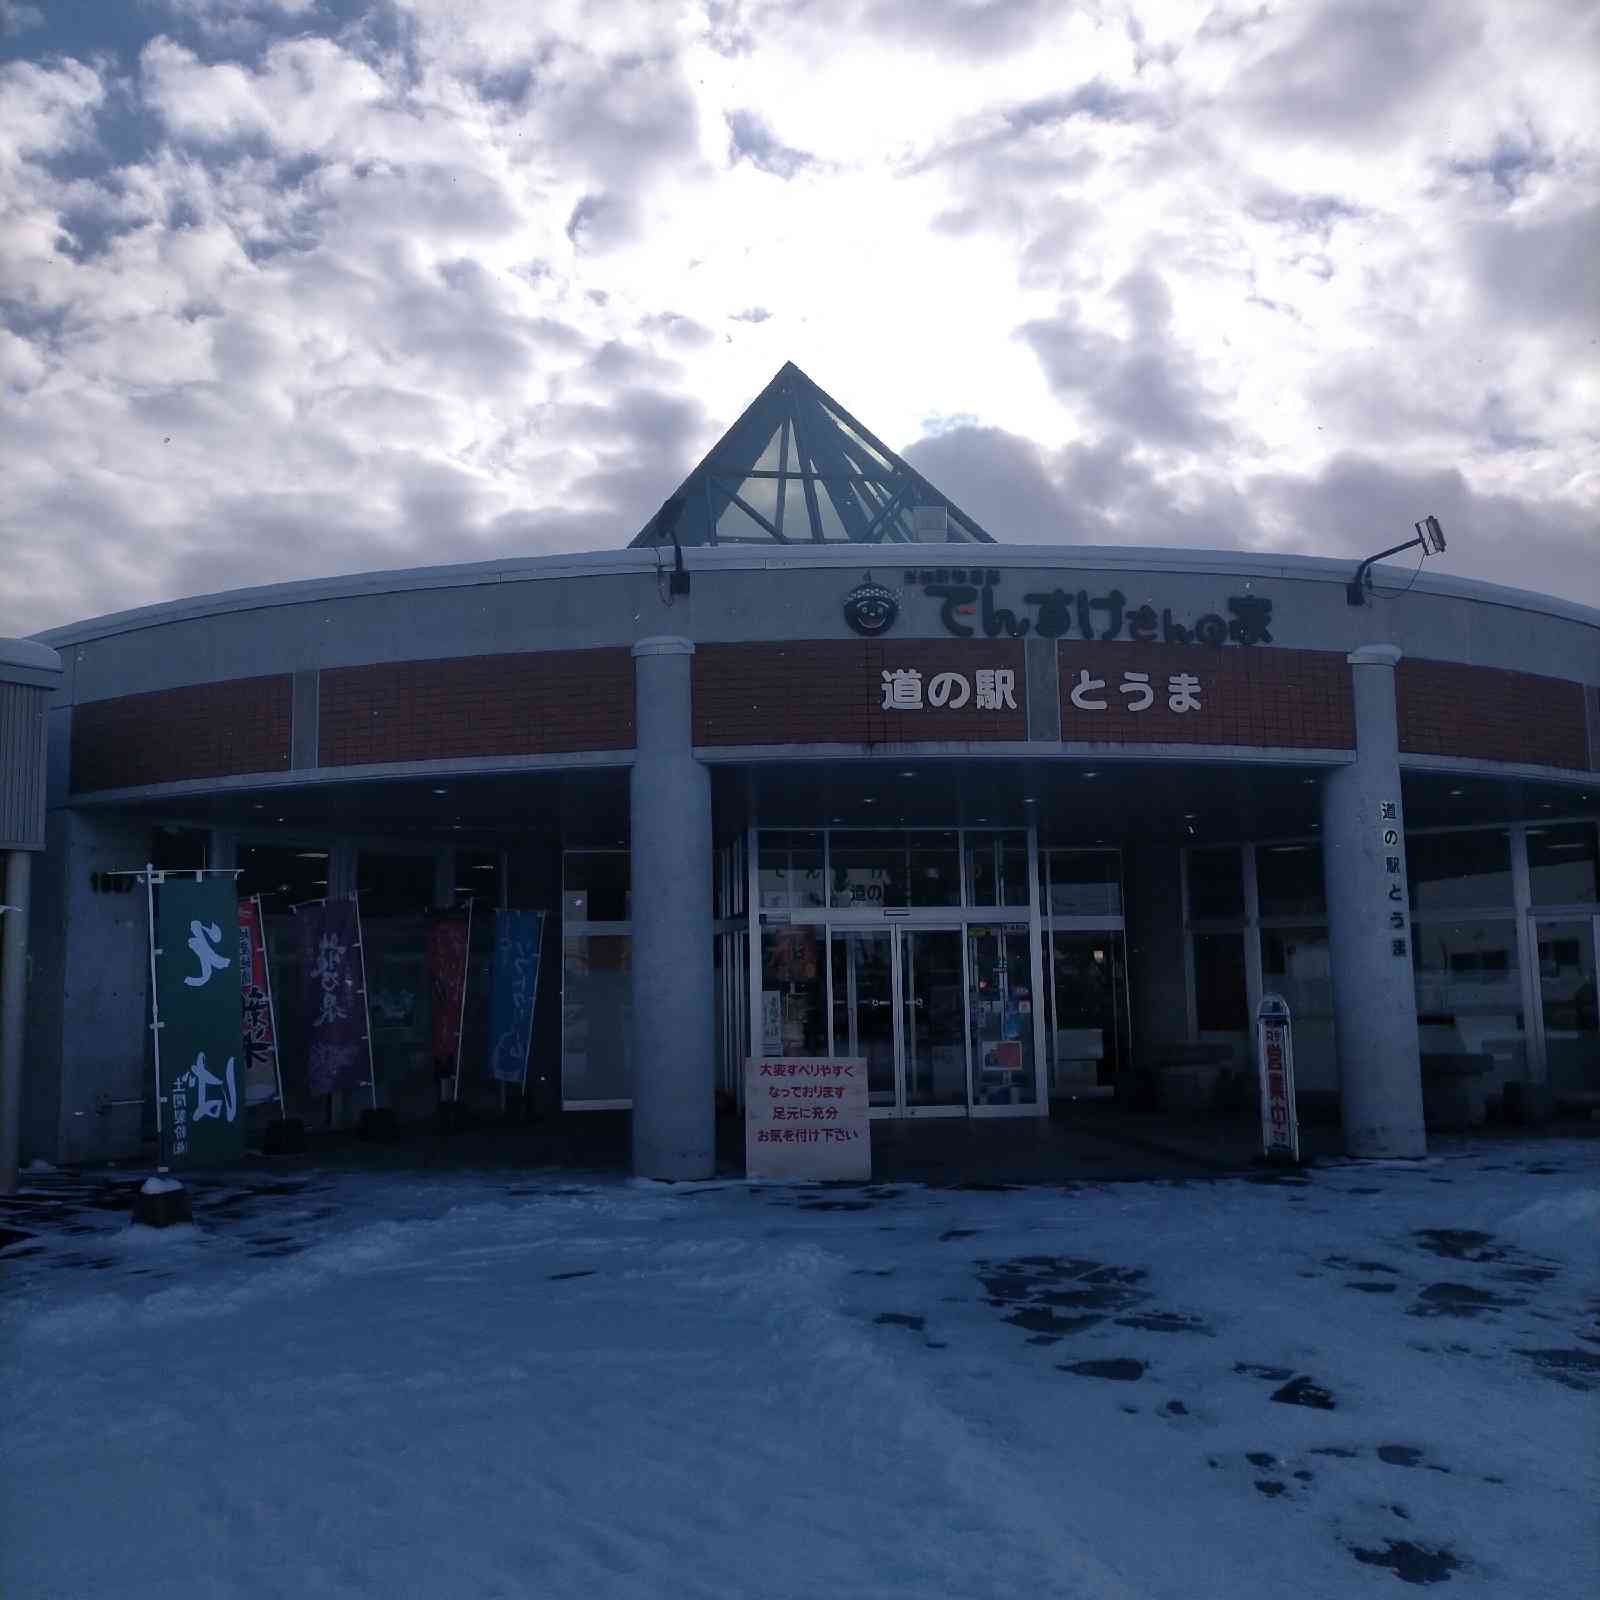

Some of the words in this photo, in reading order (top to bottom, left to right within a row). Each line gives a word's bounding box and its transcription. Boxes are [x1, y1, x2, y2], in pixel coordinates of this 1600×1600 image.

[881, 669, 1017, 711] 道の駅
[1070, 669, 1203, 713] とうま
[1381, 802, 1406, 957] 道の駅とうま
[760, 1063, 855, 1078] 大変すべりやすく
[768, 1086, 846, 1099] なっております
[772, 1106, 840, 1121] 足元に充分
[757, 1128, 860, 1143] お気を付け下さい
